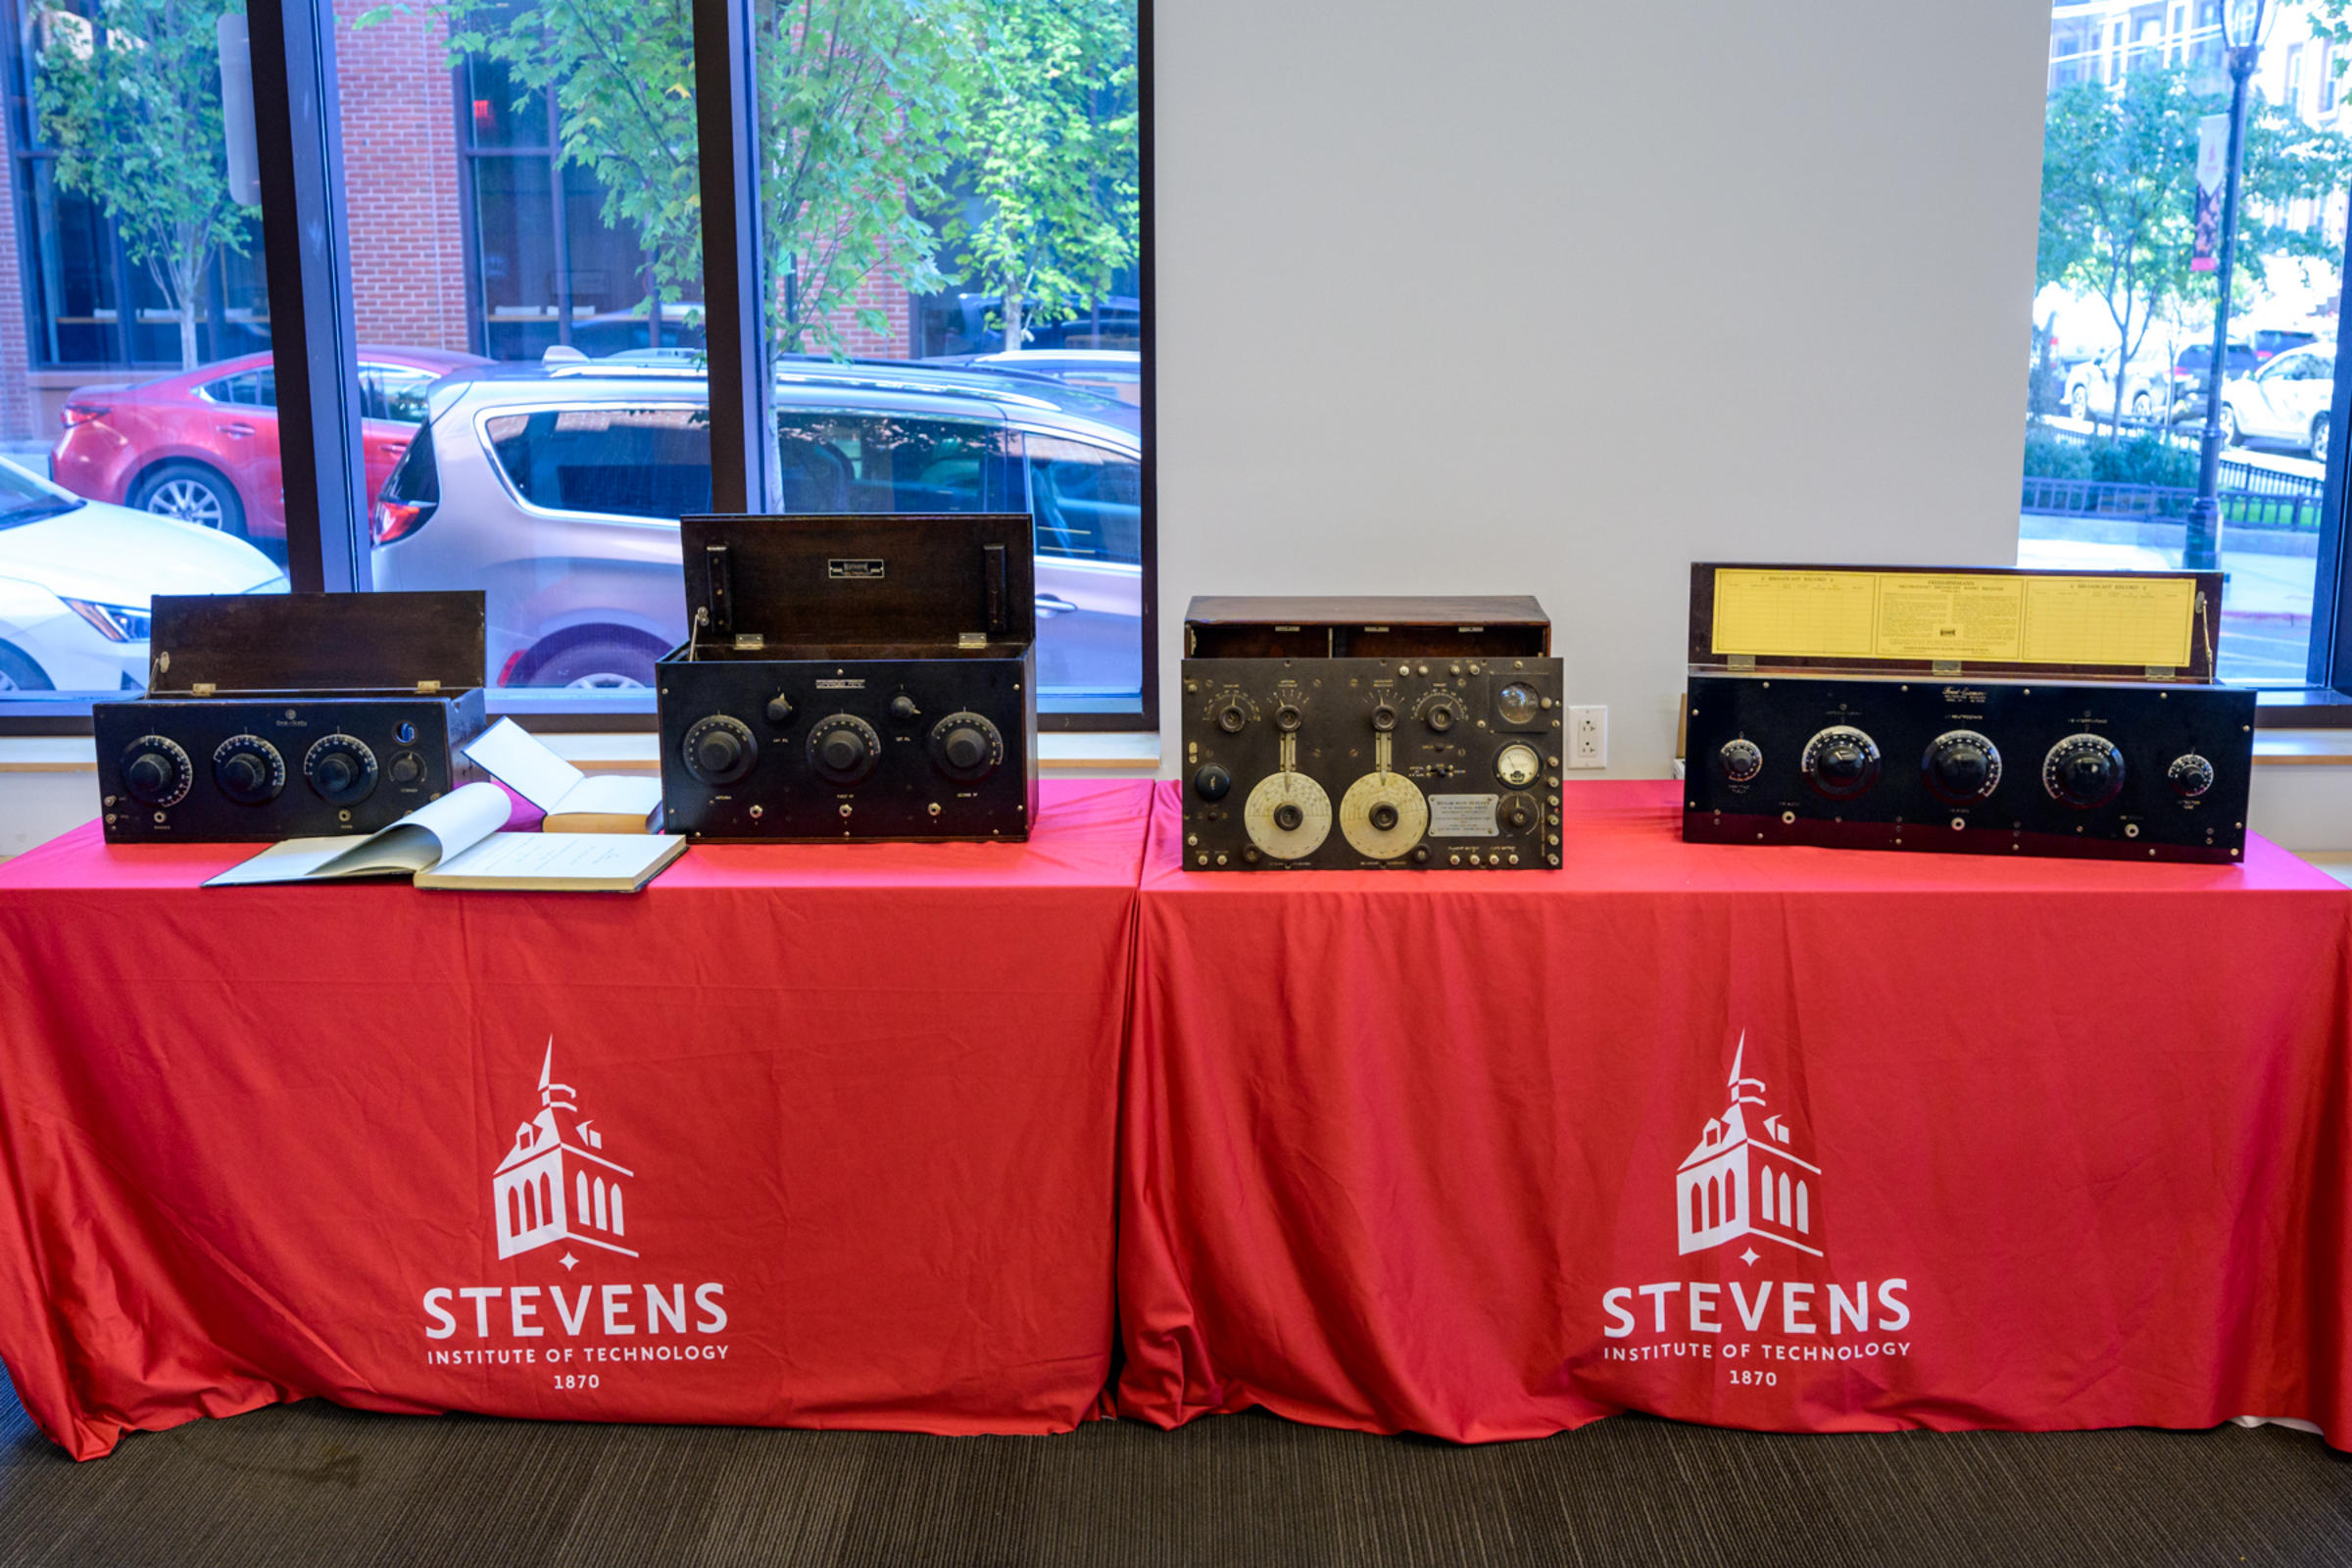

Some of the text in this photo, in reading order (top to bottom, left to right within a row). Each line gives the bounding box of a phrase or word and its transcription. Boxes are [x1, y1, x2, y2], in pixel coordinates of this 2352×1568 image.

[422, 1282, 728, 1340] STEVENS
[1602, 1278, 1910, 1339] STEVENS
[427, 1345, 729, 1365] INSTITUTE OF TECHNOLOGY
[1603, 1342, 1911, 1361] INSTITUTE OF TECHNOLOGY
[554, 1375, 600, 1390] 1870
[1730, 1370, 1777, 1387] 1870
